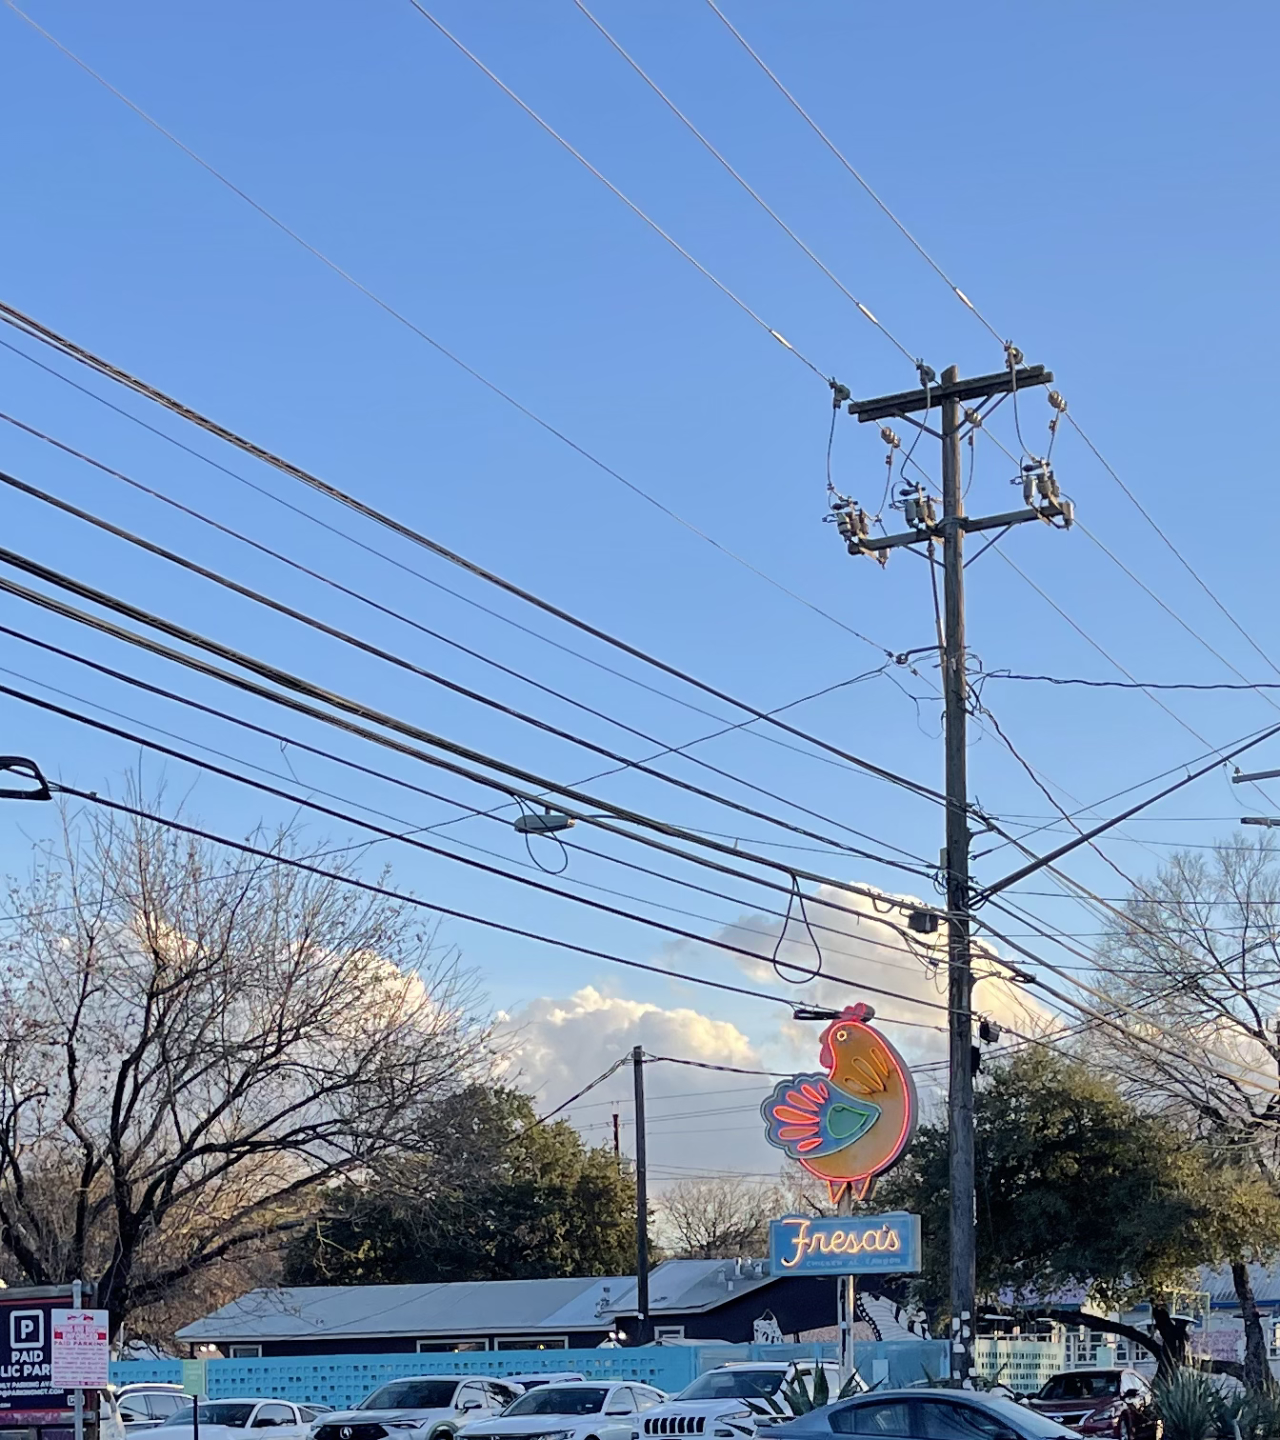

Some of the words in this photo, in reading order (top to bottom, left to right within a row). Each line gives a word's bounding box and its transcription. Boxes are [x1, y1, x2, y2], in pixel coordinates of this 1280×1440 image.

[781, 1219, 901, 1267] Fresa's
[21, 1319, 34, 1339] P
[11, 1350, 43, 1363] PAID
[23, 1364, 52, 1377] PAR
